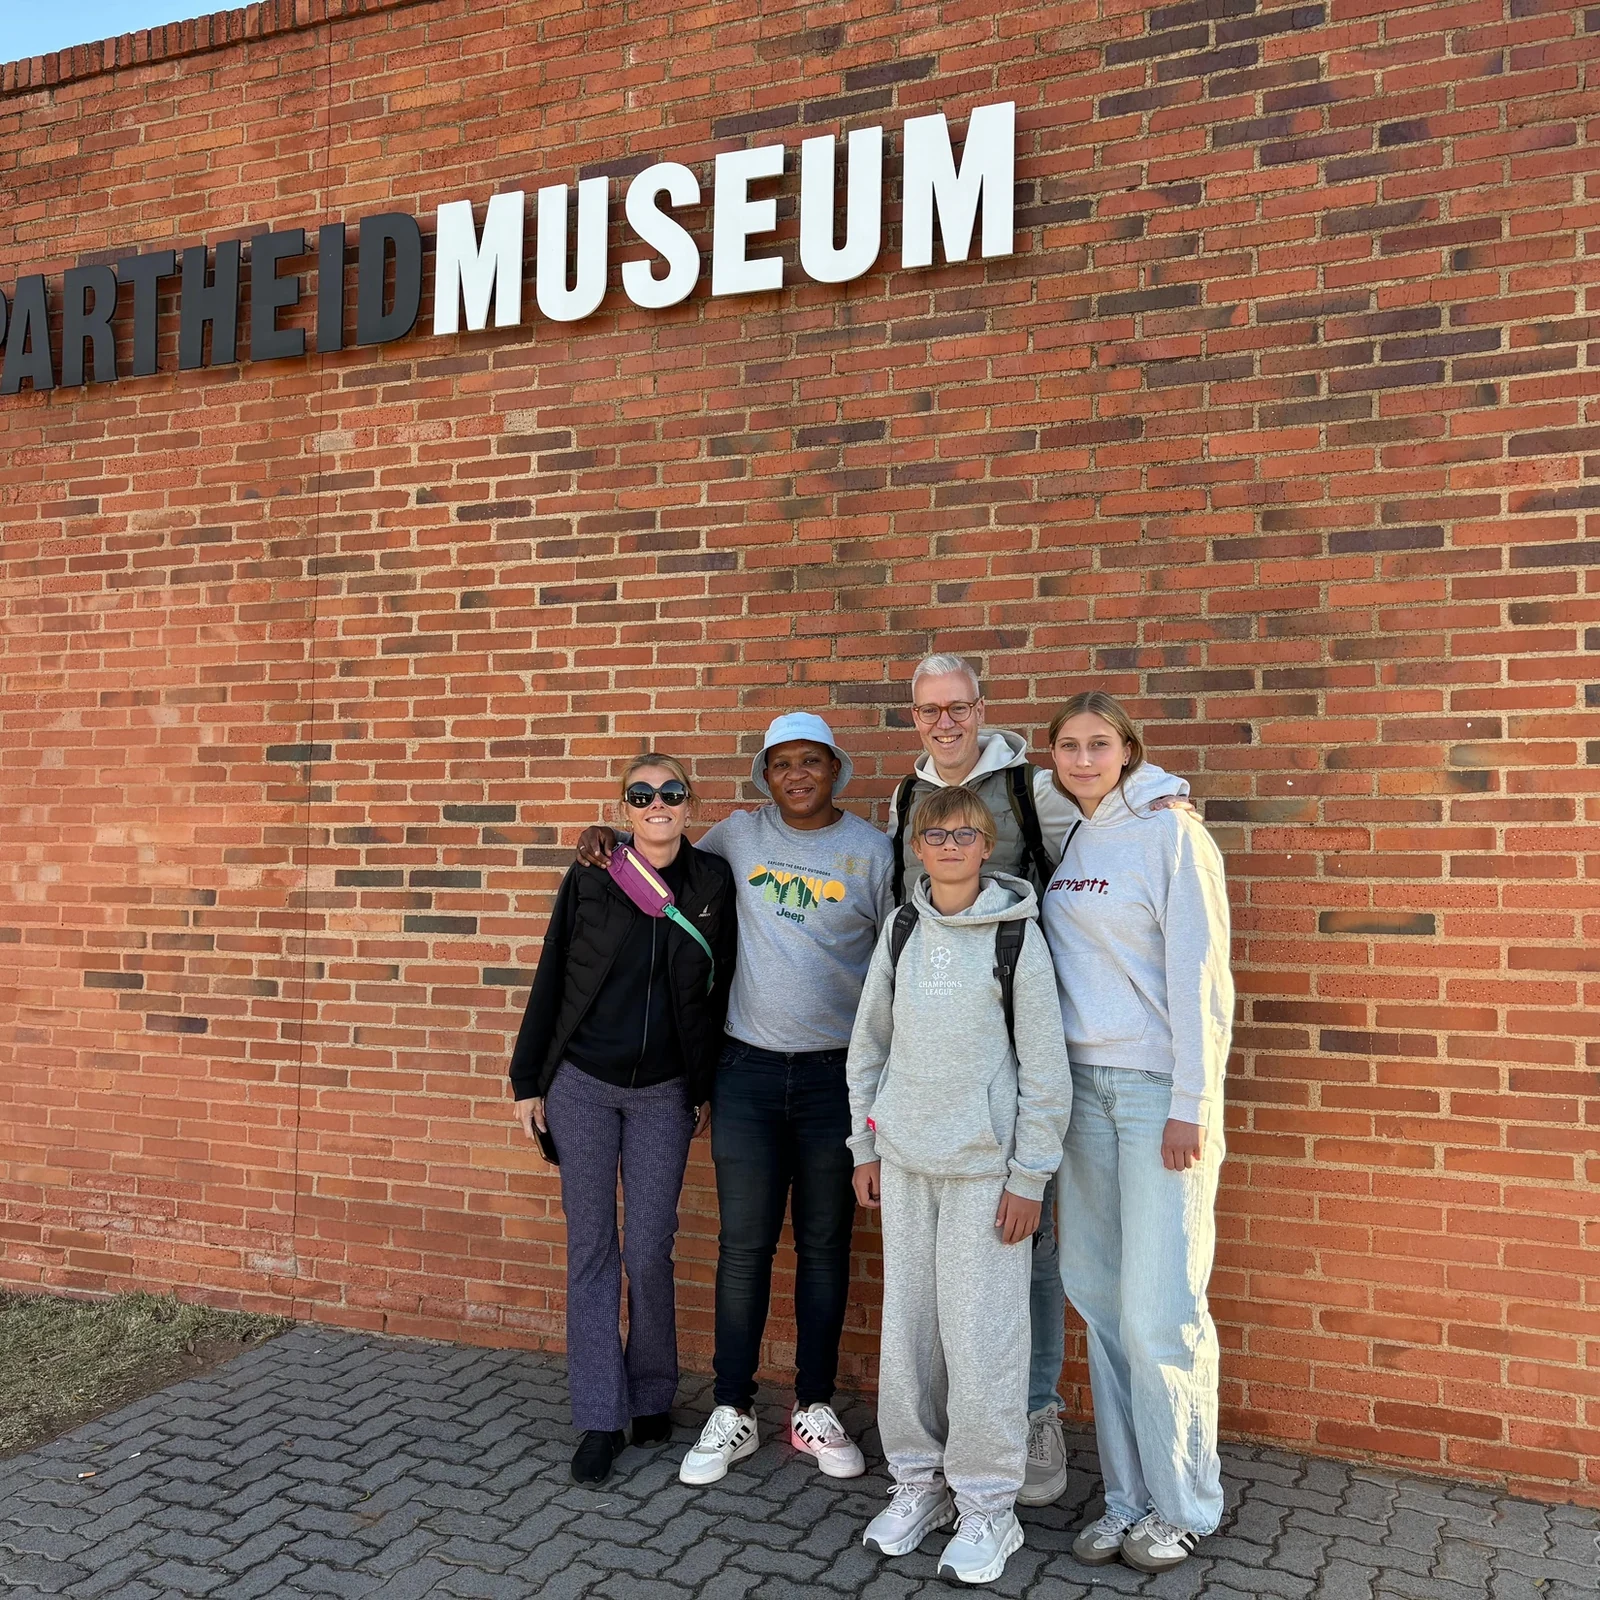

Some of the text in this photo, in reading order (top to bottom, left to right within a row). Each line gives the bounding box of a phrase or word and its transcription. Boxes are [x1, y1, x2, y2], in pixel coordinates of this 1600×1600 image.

[0, 101, 1016, 395] ARTHEID MUSEUM
[807, 867, 831, 877] OUTDOORS
[776, 907, 805, 924] Jeep
[918, 980, 963, 988] CHAMPIONS
[925, 988, 954, 996] LEAGUE
